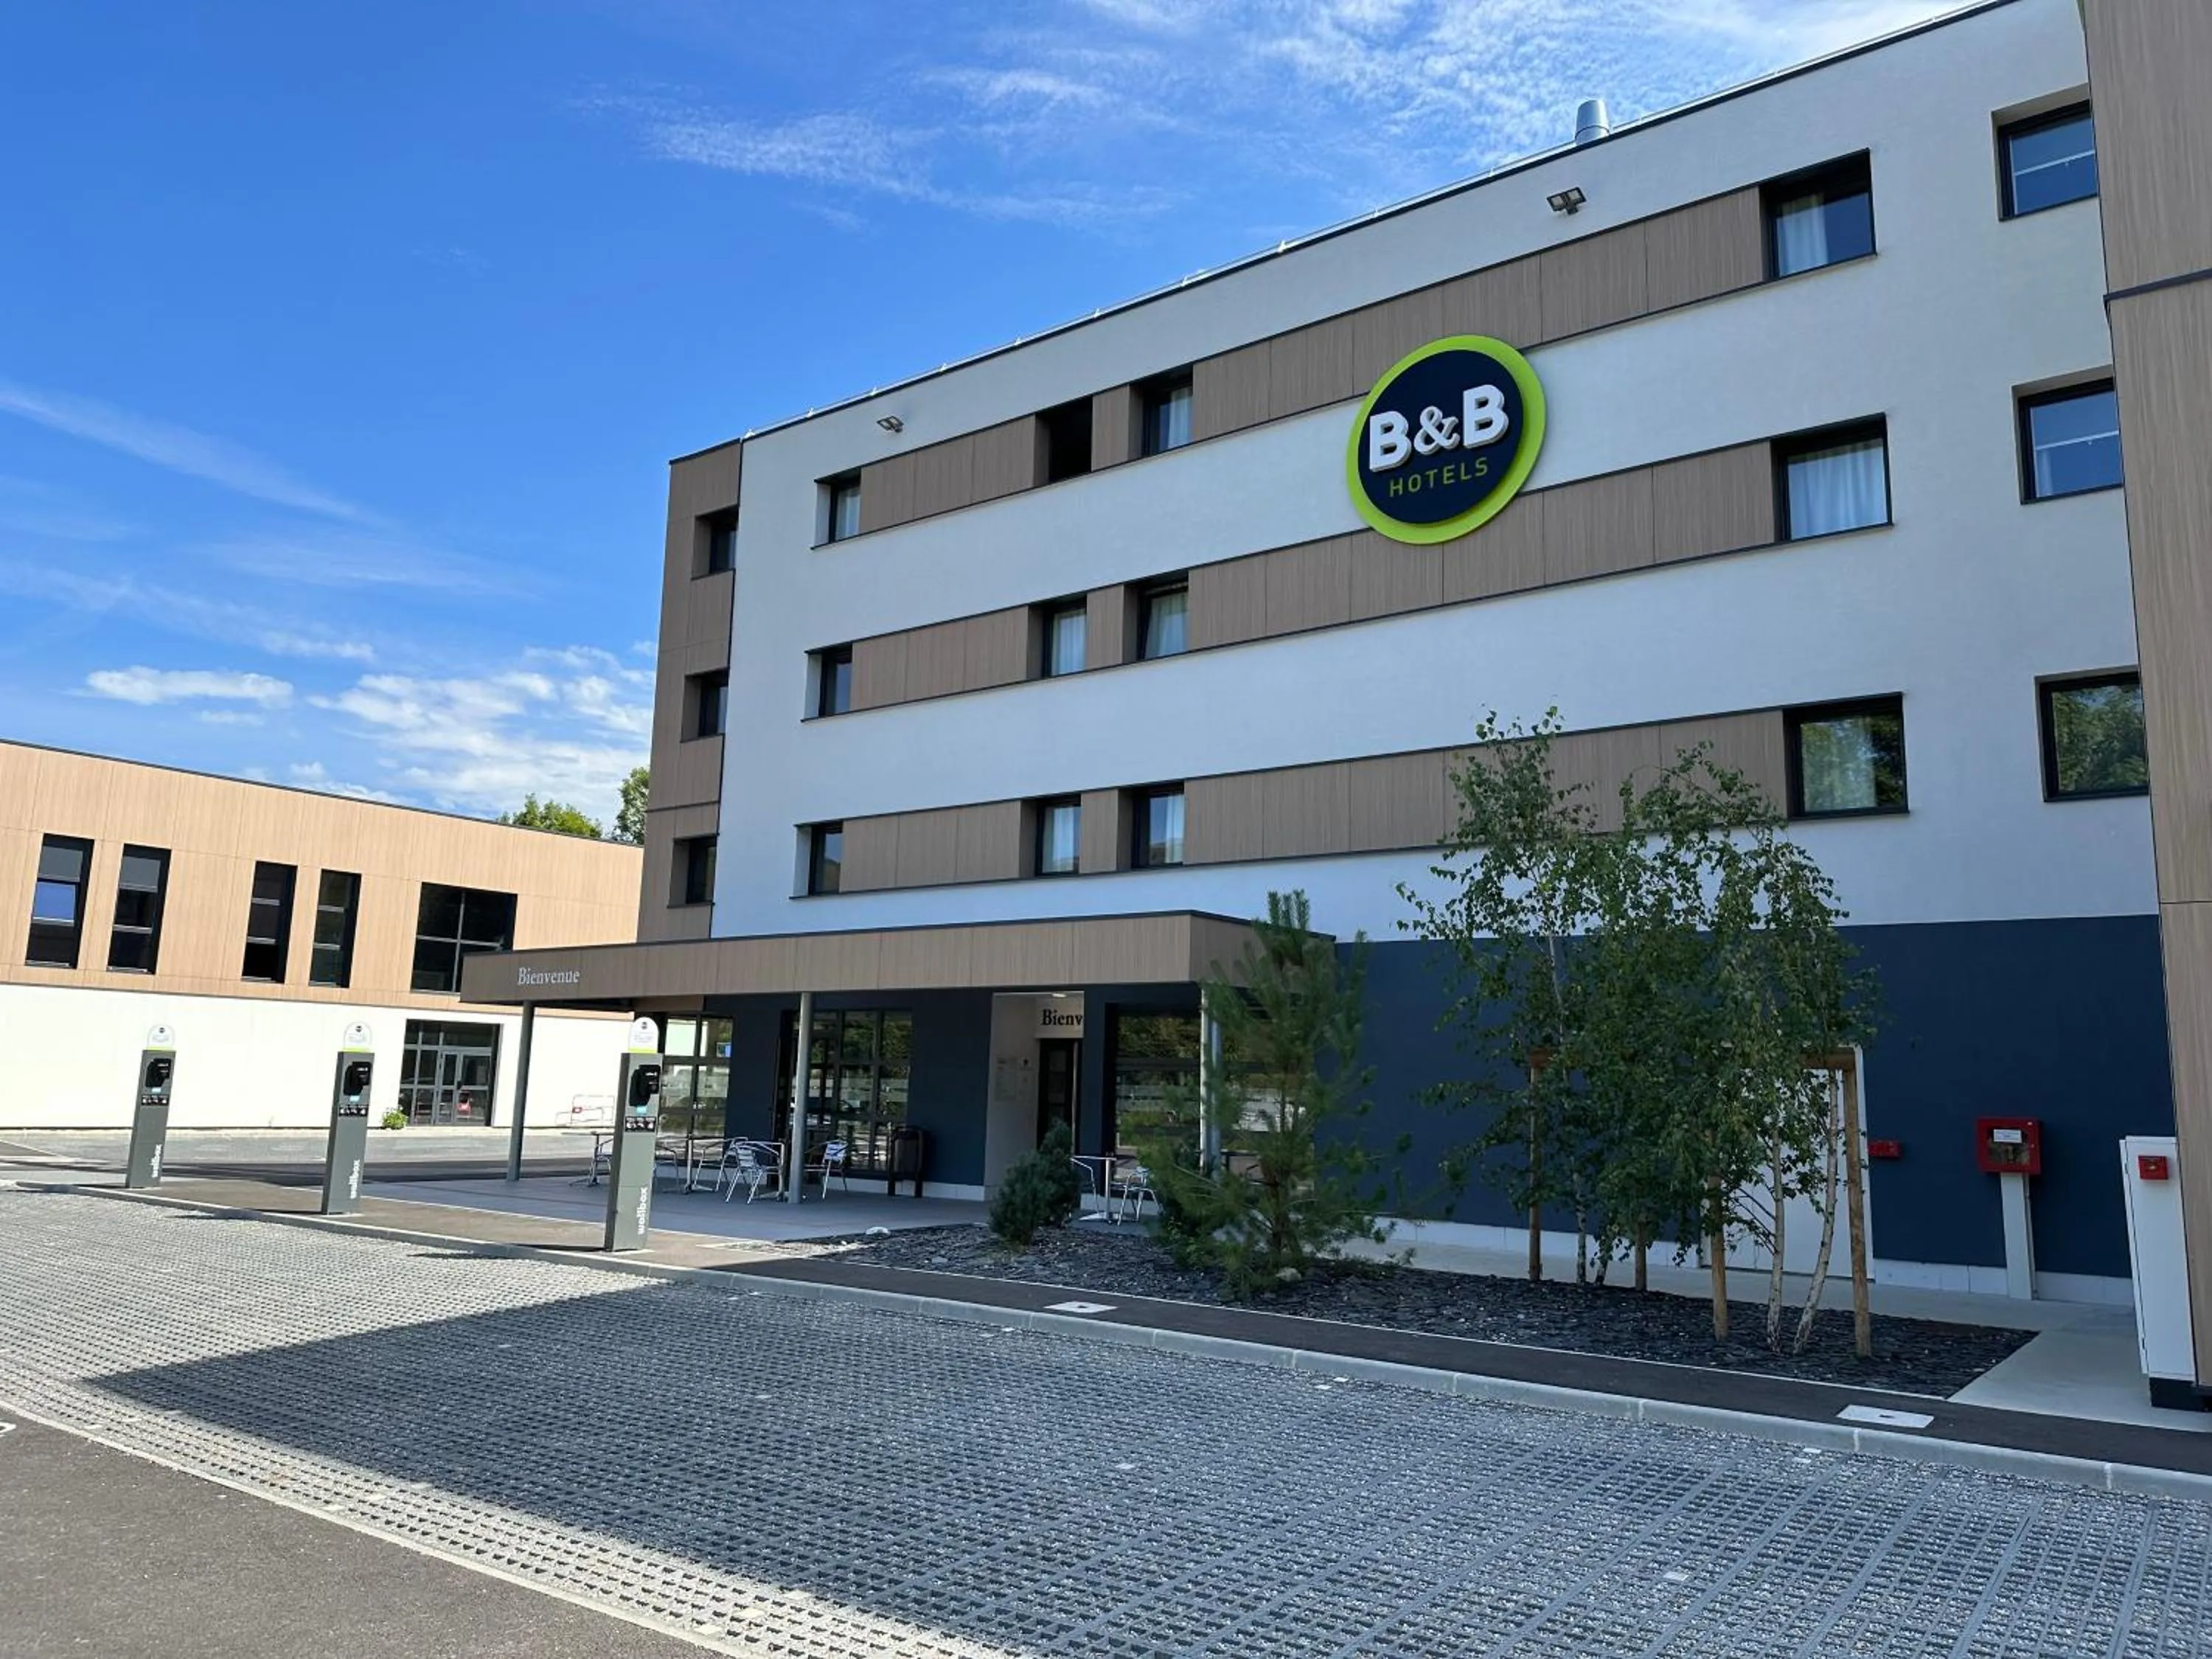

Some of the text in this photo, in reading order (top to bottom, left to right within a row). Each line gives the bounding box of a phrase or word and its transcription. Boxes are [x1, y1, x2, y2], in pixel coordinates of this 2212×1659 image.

[1369, 384, 1509, 472] B&B
[1389, 457, 1489, 497] HOTELS
[518, 967, 580, 985] Bienvenue
[636, 1186, 647, 1235] wallbox
